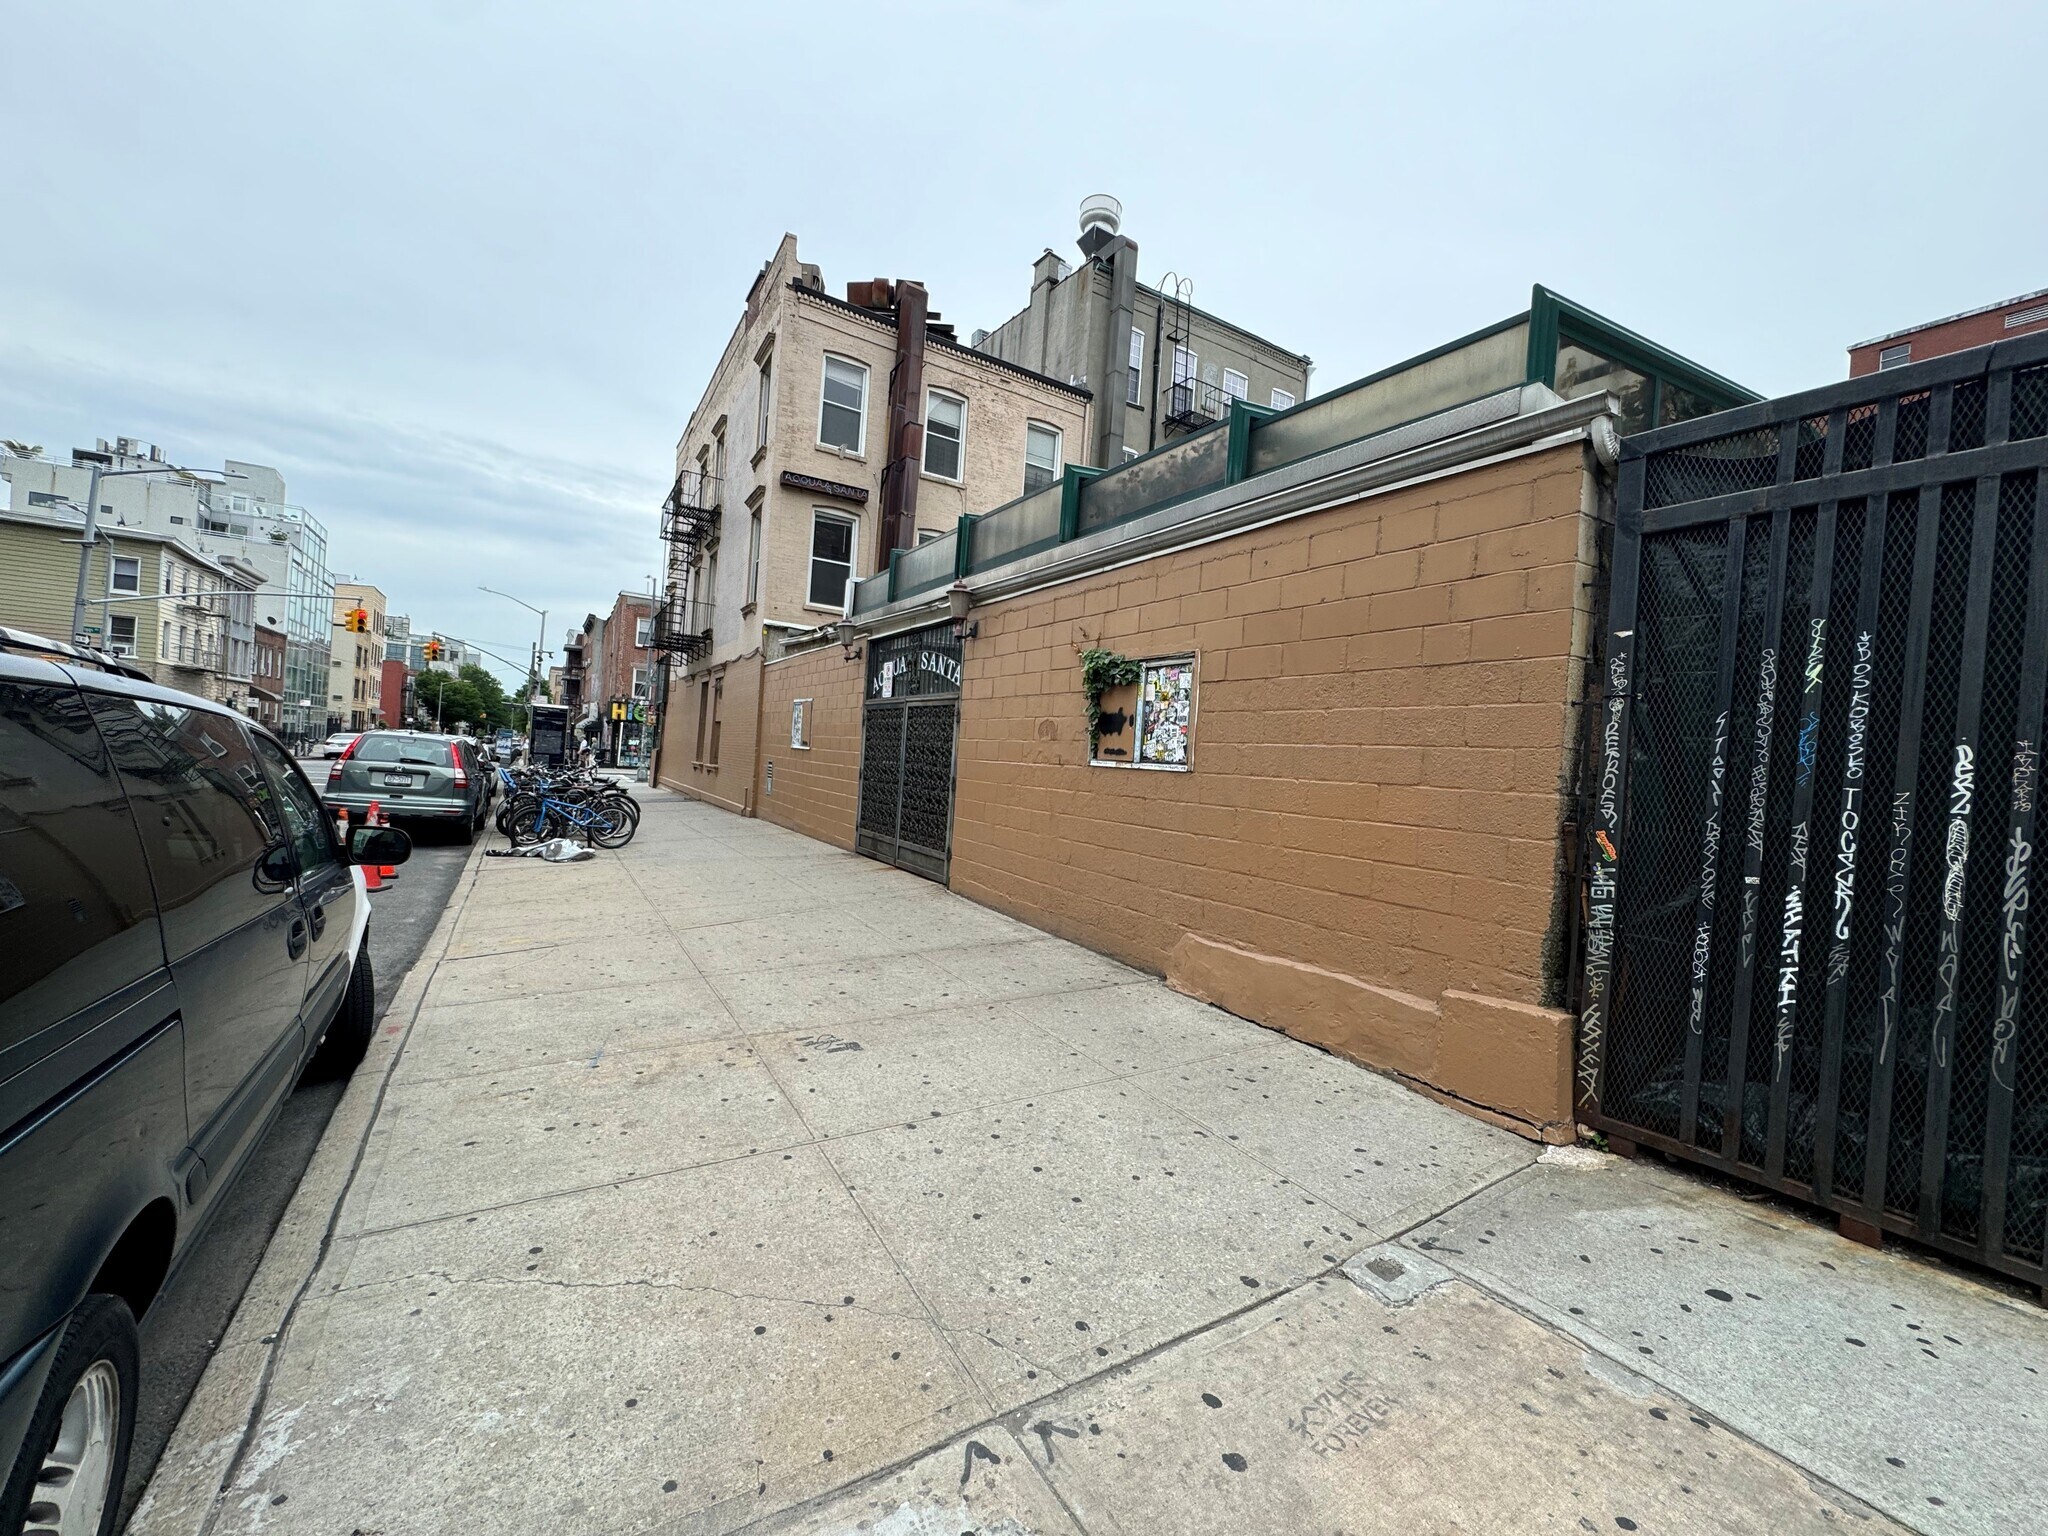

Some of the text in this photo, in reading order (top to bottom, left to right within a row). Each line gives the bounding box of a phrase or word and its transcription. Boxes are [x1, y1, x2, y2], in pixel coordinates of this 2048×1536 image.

[833, 484, 868, 499] SANTA
[872, 655, 907, 695] ACUA
[920, 651, 961, 687] SANTA
